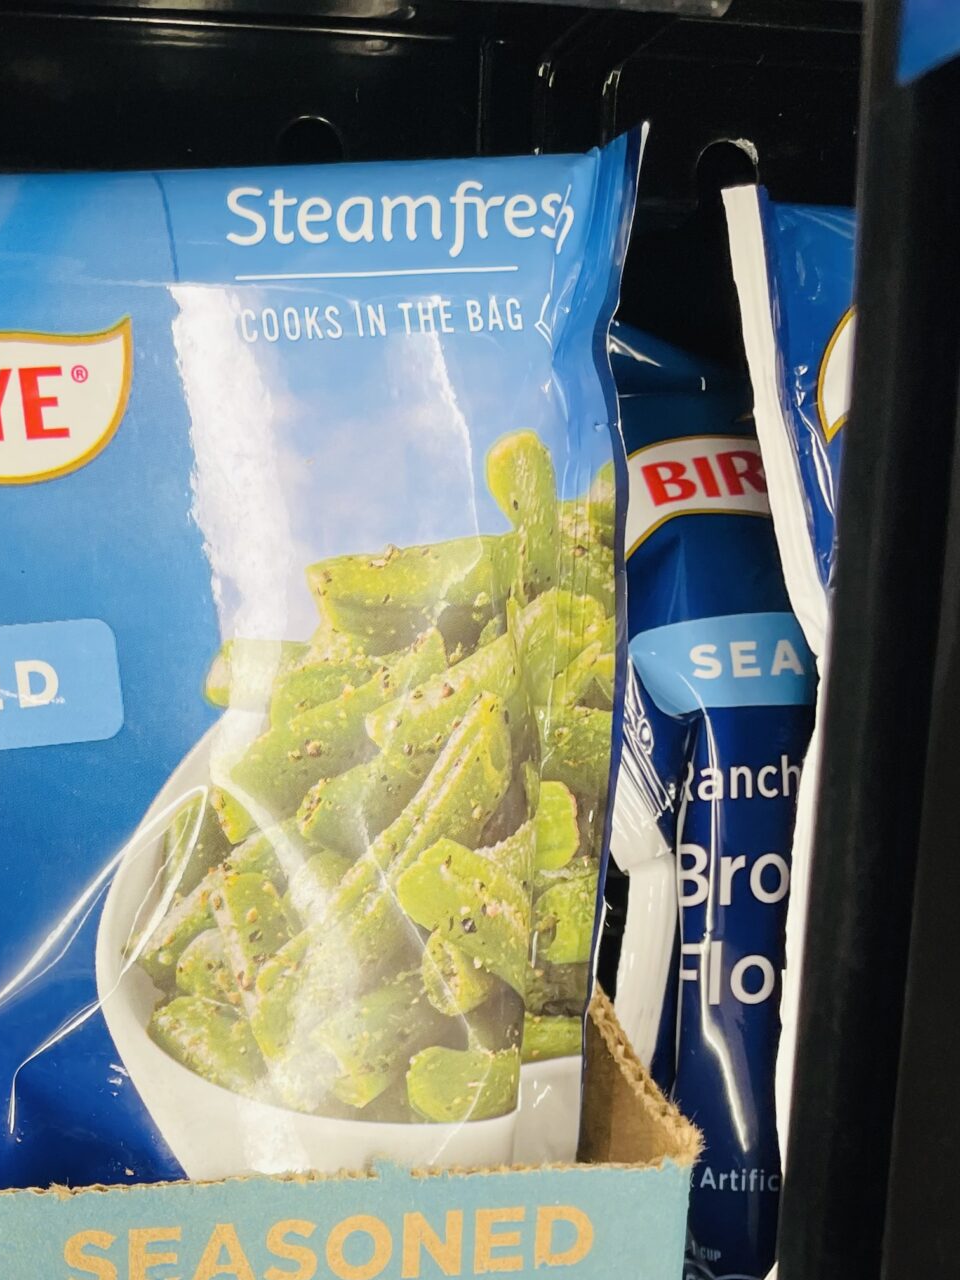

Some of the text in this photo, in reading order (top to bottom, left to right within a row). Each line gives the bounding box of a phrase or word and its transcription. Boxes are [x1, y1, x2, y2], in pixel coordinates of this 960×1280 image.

[240, 296, 523, 343] COOKS IN THE BAG
[689, 639, 804, 680] SEA
